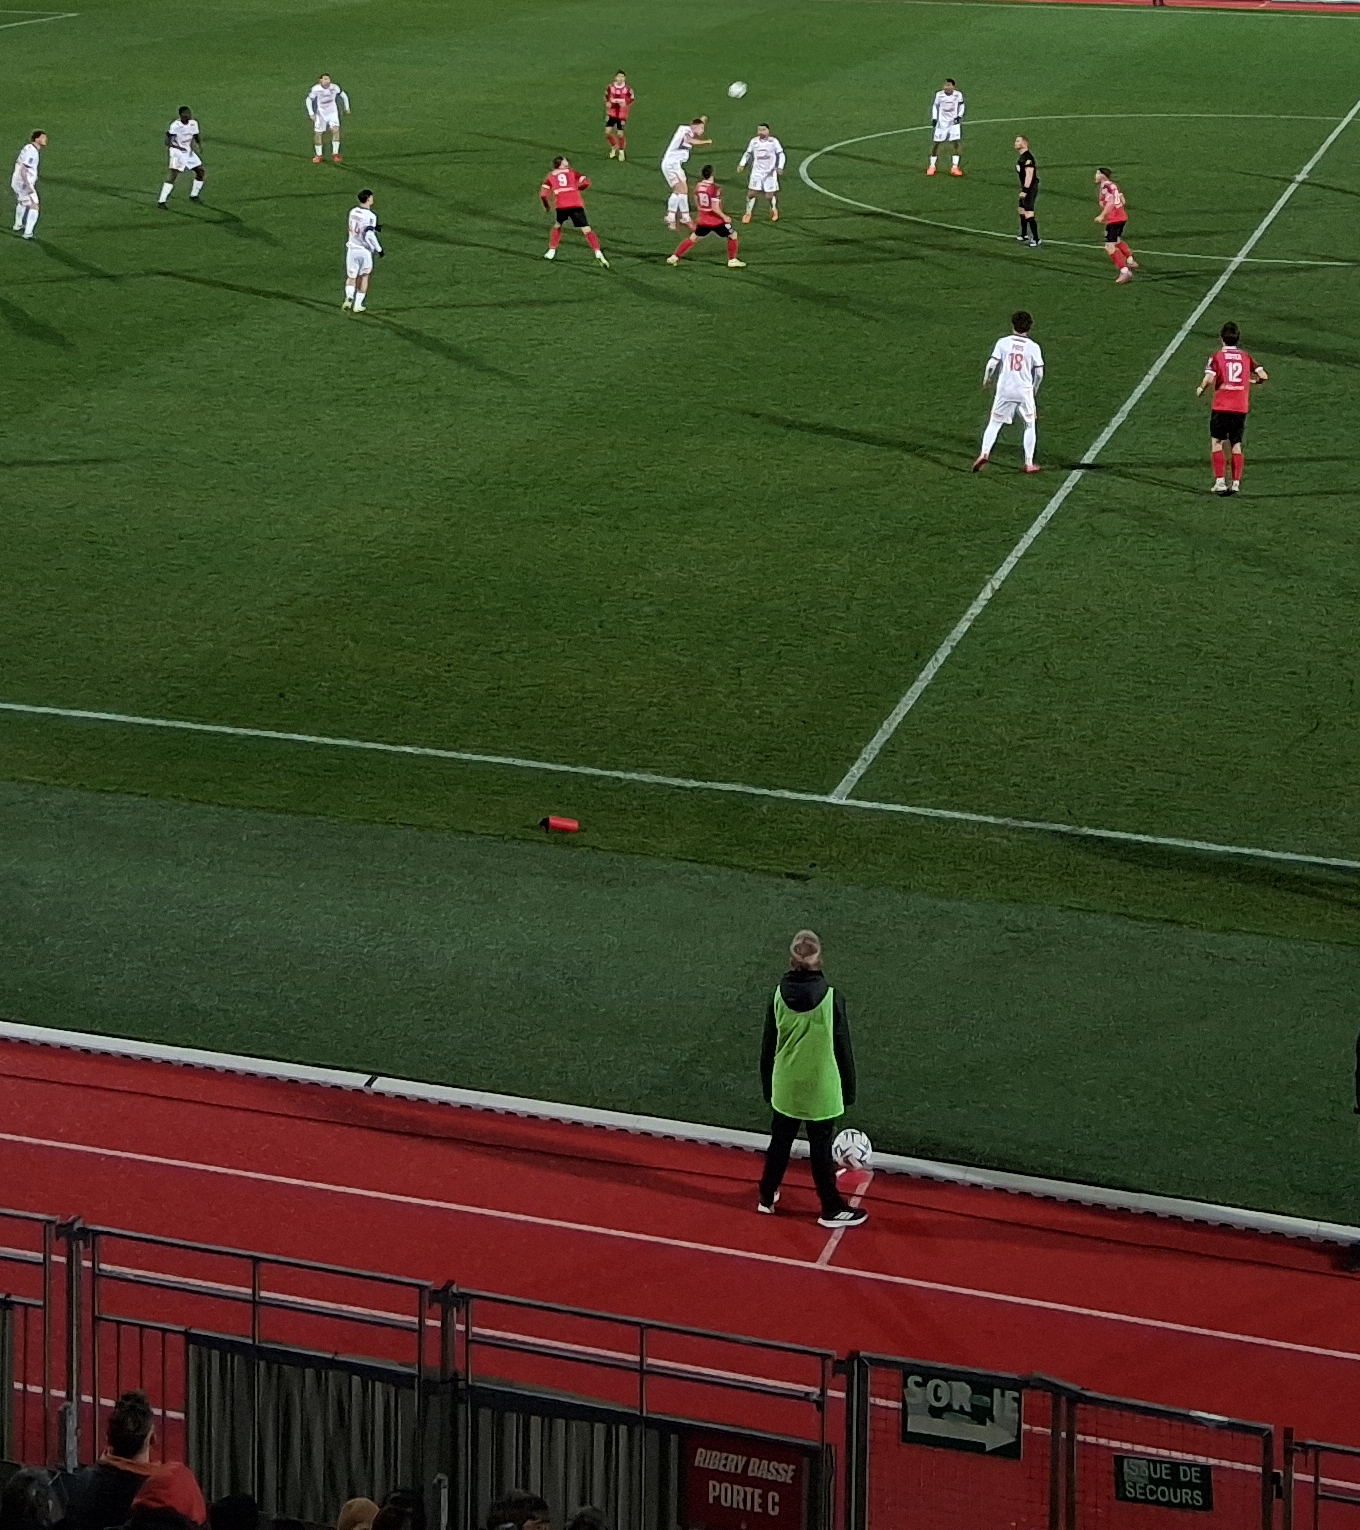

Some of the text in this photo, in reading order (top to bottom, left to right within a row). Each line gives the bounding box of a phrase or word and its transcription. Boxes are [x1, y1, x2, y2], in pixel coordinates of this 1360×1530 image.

[557, 174, 568, 187] 9
[1009, 353, 1023, 371] 18
[1226, 362, 1243, 383] 12
[694, 1447, 796, 1484] RIBERY BASSE
[1179, 1465, 1202, 1484] DE
[708, 1480, 780, 1516] PORTE C
[1125, 1481, 1204, 1506] SECOURS
